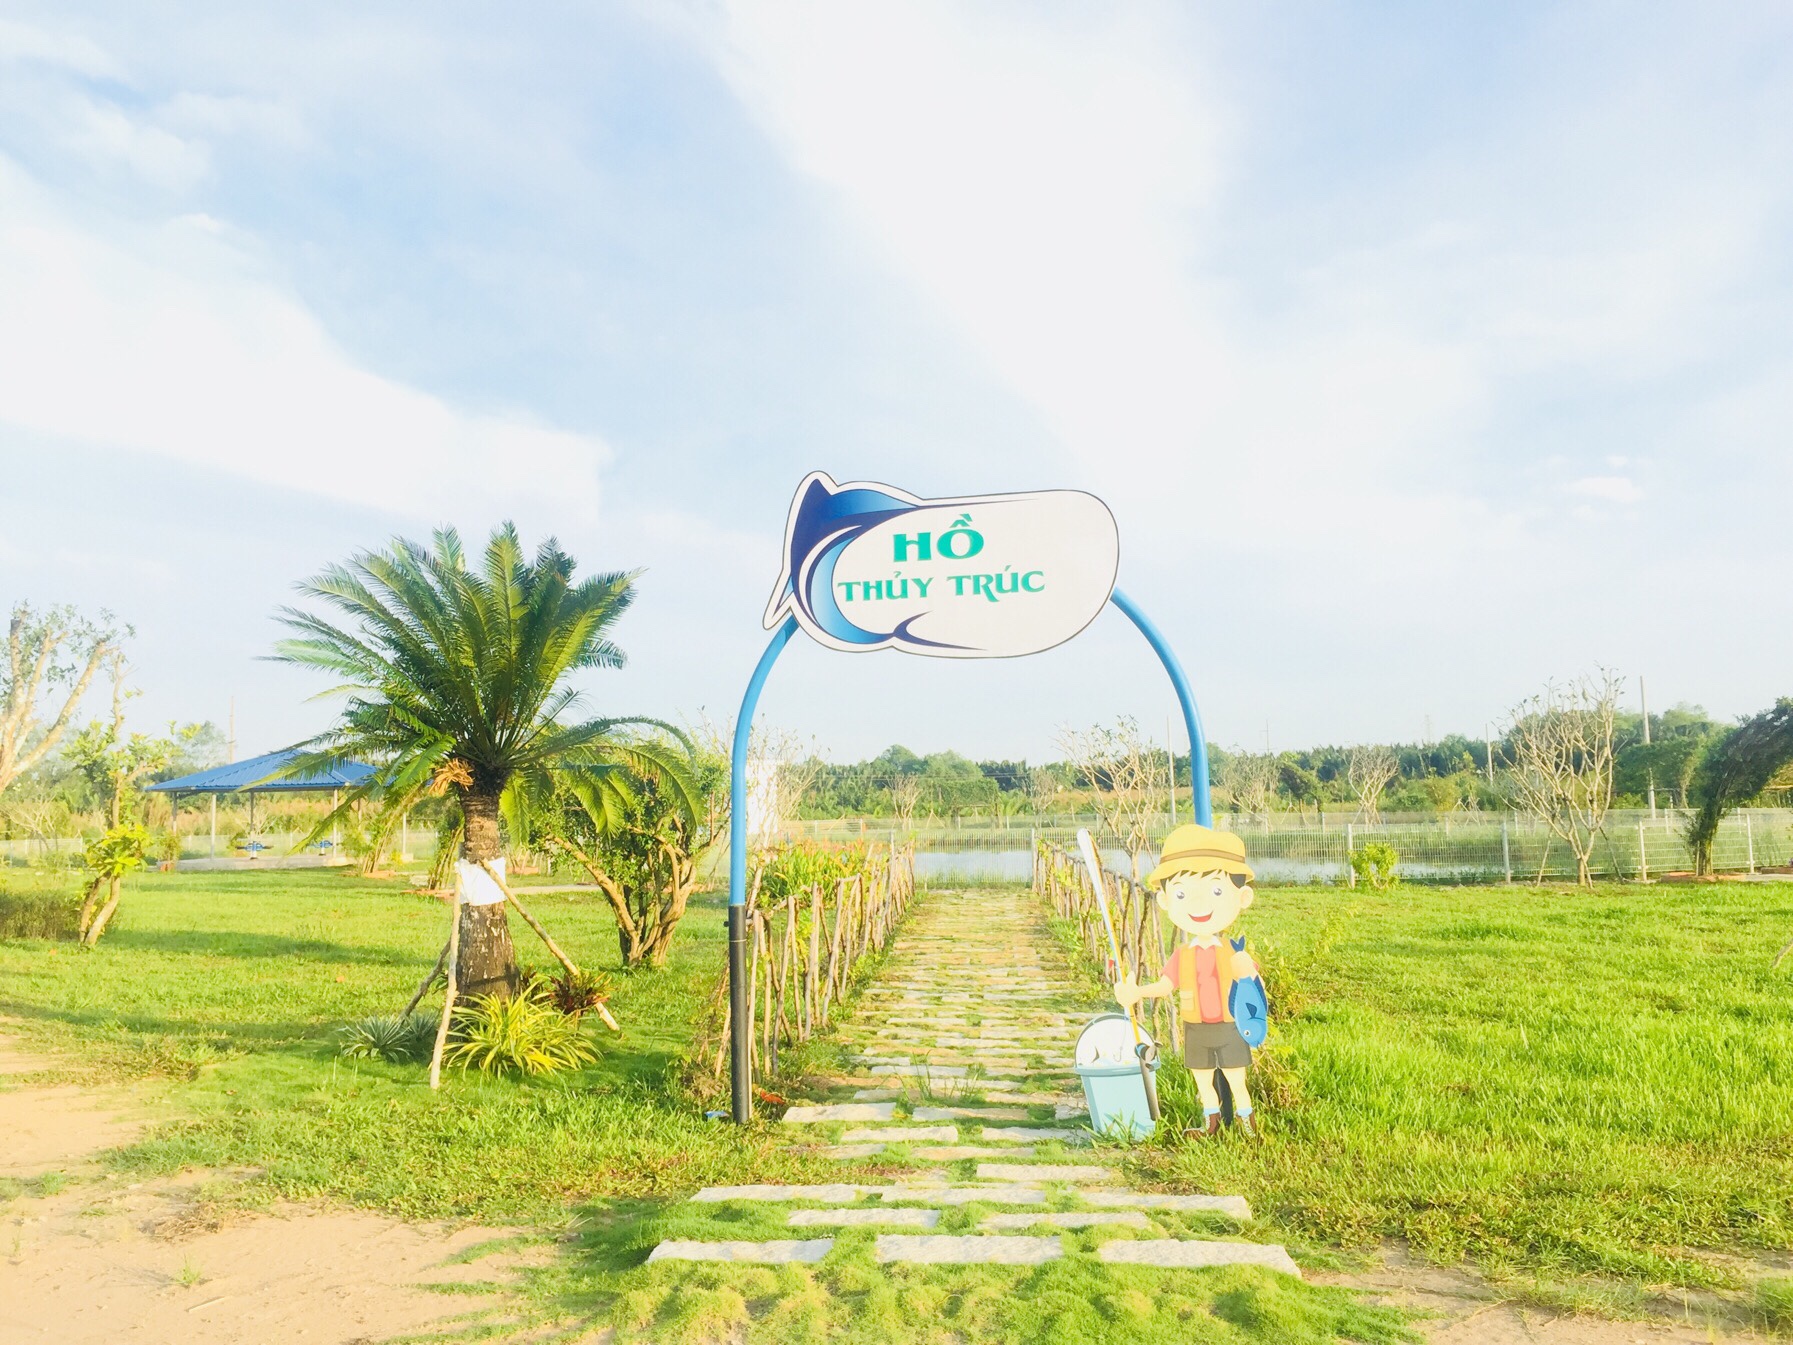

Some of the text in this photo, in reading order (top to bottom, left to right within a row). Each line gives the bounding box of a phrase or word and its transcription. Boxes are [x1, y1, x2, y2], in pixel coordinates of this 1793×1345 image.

[892, 513, 985, 562] HỒ
[837, 565, 1045, 602] THỦY TRÚC
